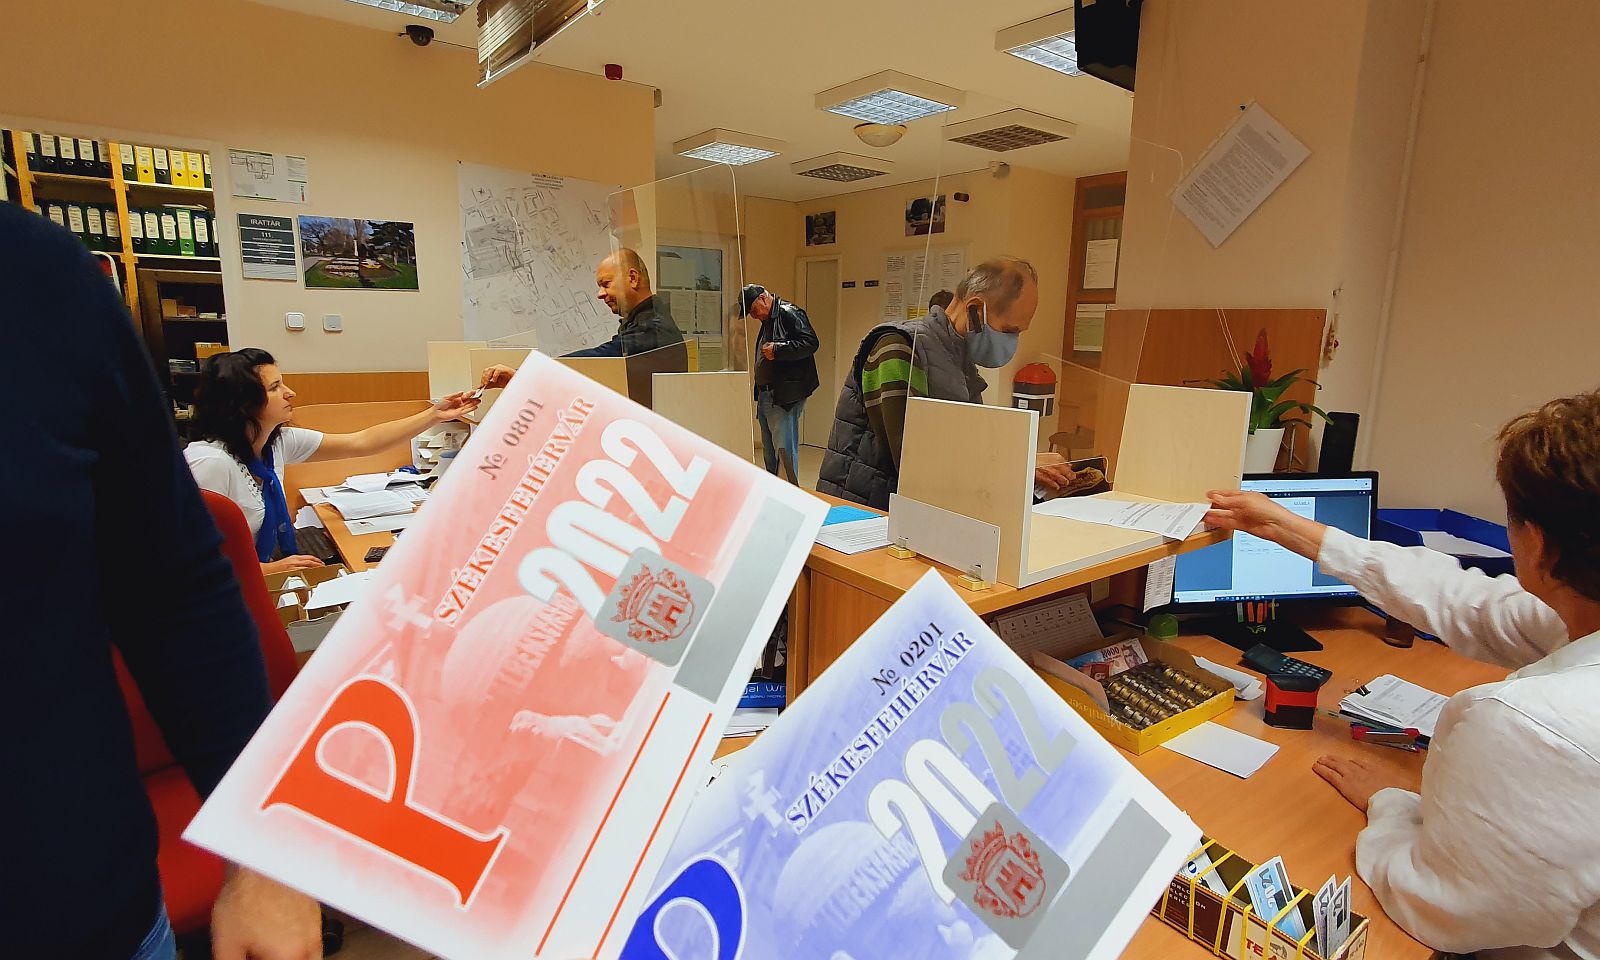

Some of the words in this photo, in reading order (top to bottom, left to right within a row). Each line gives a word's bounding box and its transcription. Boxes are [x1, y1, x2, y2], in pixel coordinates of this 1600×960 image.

[437, 397, 595, 626] SZÉKESFEHÉRVÁR
[503, 398, 544, 448] 0801
[517, 419, 712, 619] 2022
[785, 628, 977, 832] SZÉKESFEHÉRVÁR
[900, 620, 946, 669] 0201
[261, 674, 511, 911] P
[867, 665, 1077, 906] 2022
